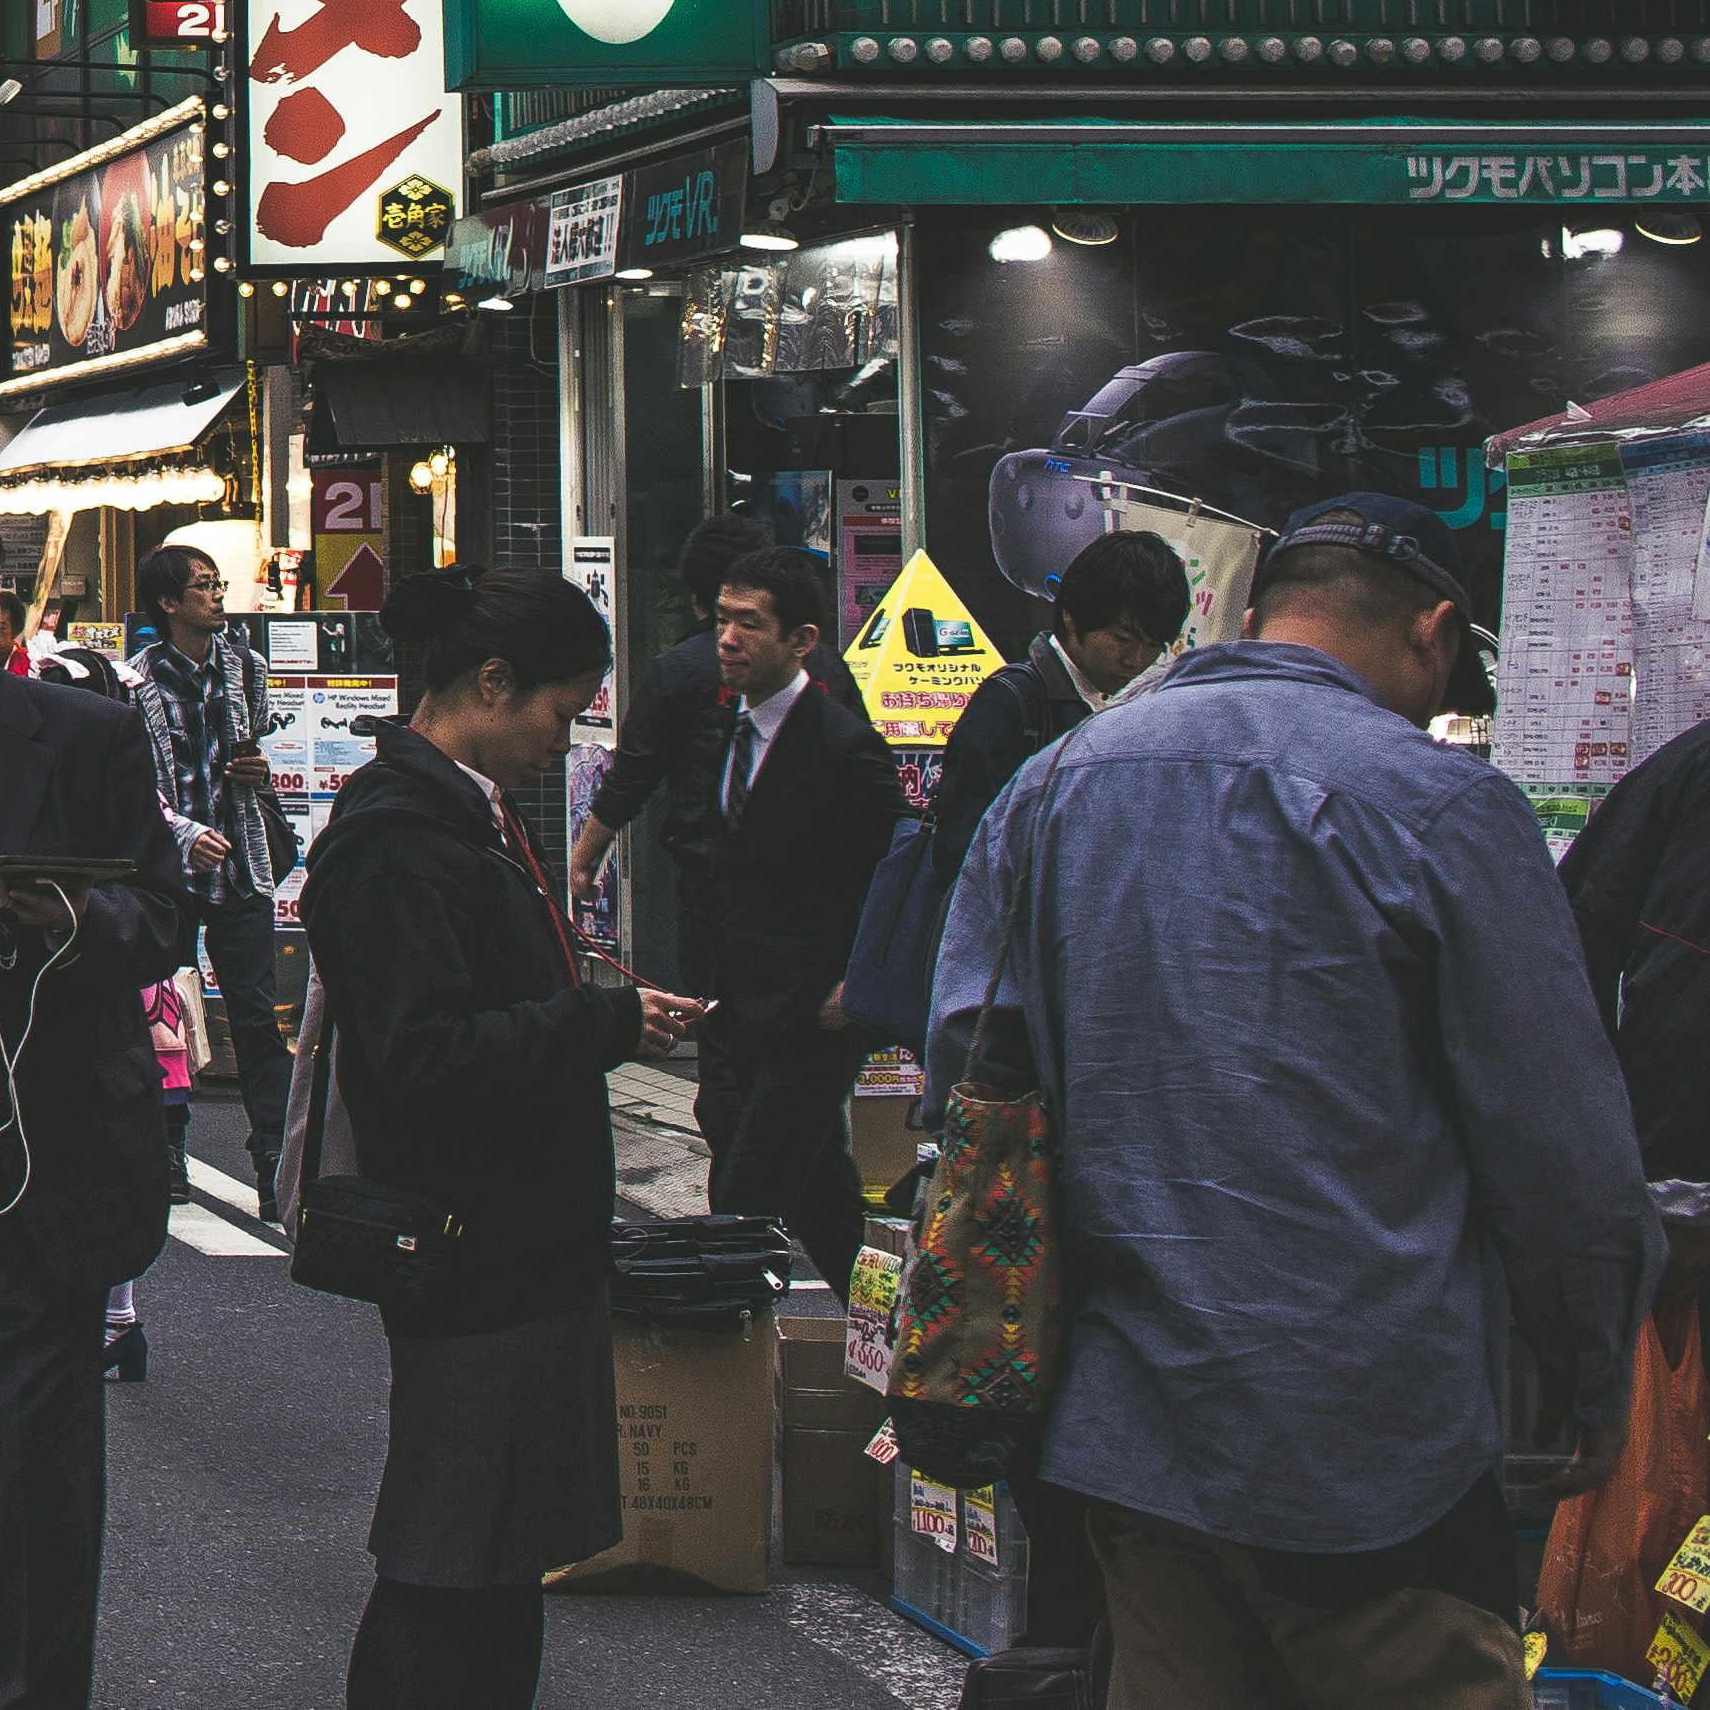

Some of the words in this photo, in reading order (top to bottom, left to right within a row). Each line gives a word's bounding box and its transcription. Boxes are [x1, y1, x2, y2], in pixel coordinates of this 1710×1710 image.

[1406, 154, 1705, 198] ツクモパソコン本
[381, 199, 449, 231] 壱角家
[338, 693, 370, 702] Windows
[629, 1423, 663, 1439] NAVY
[632, 1441, 650, 1457] 50
[636, 1460, 650, 1476] 15
